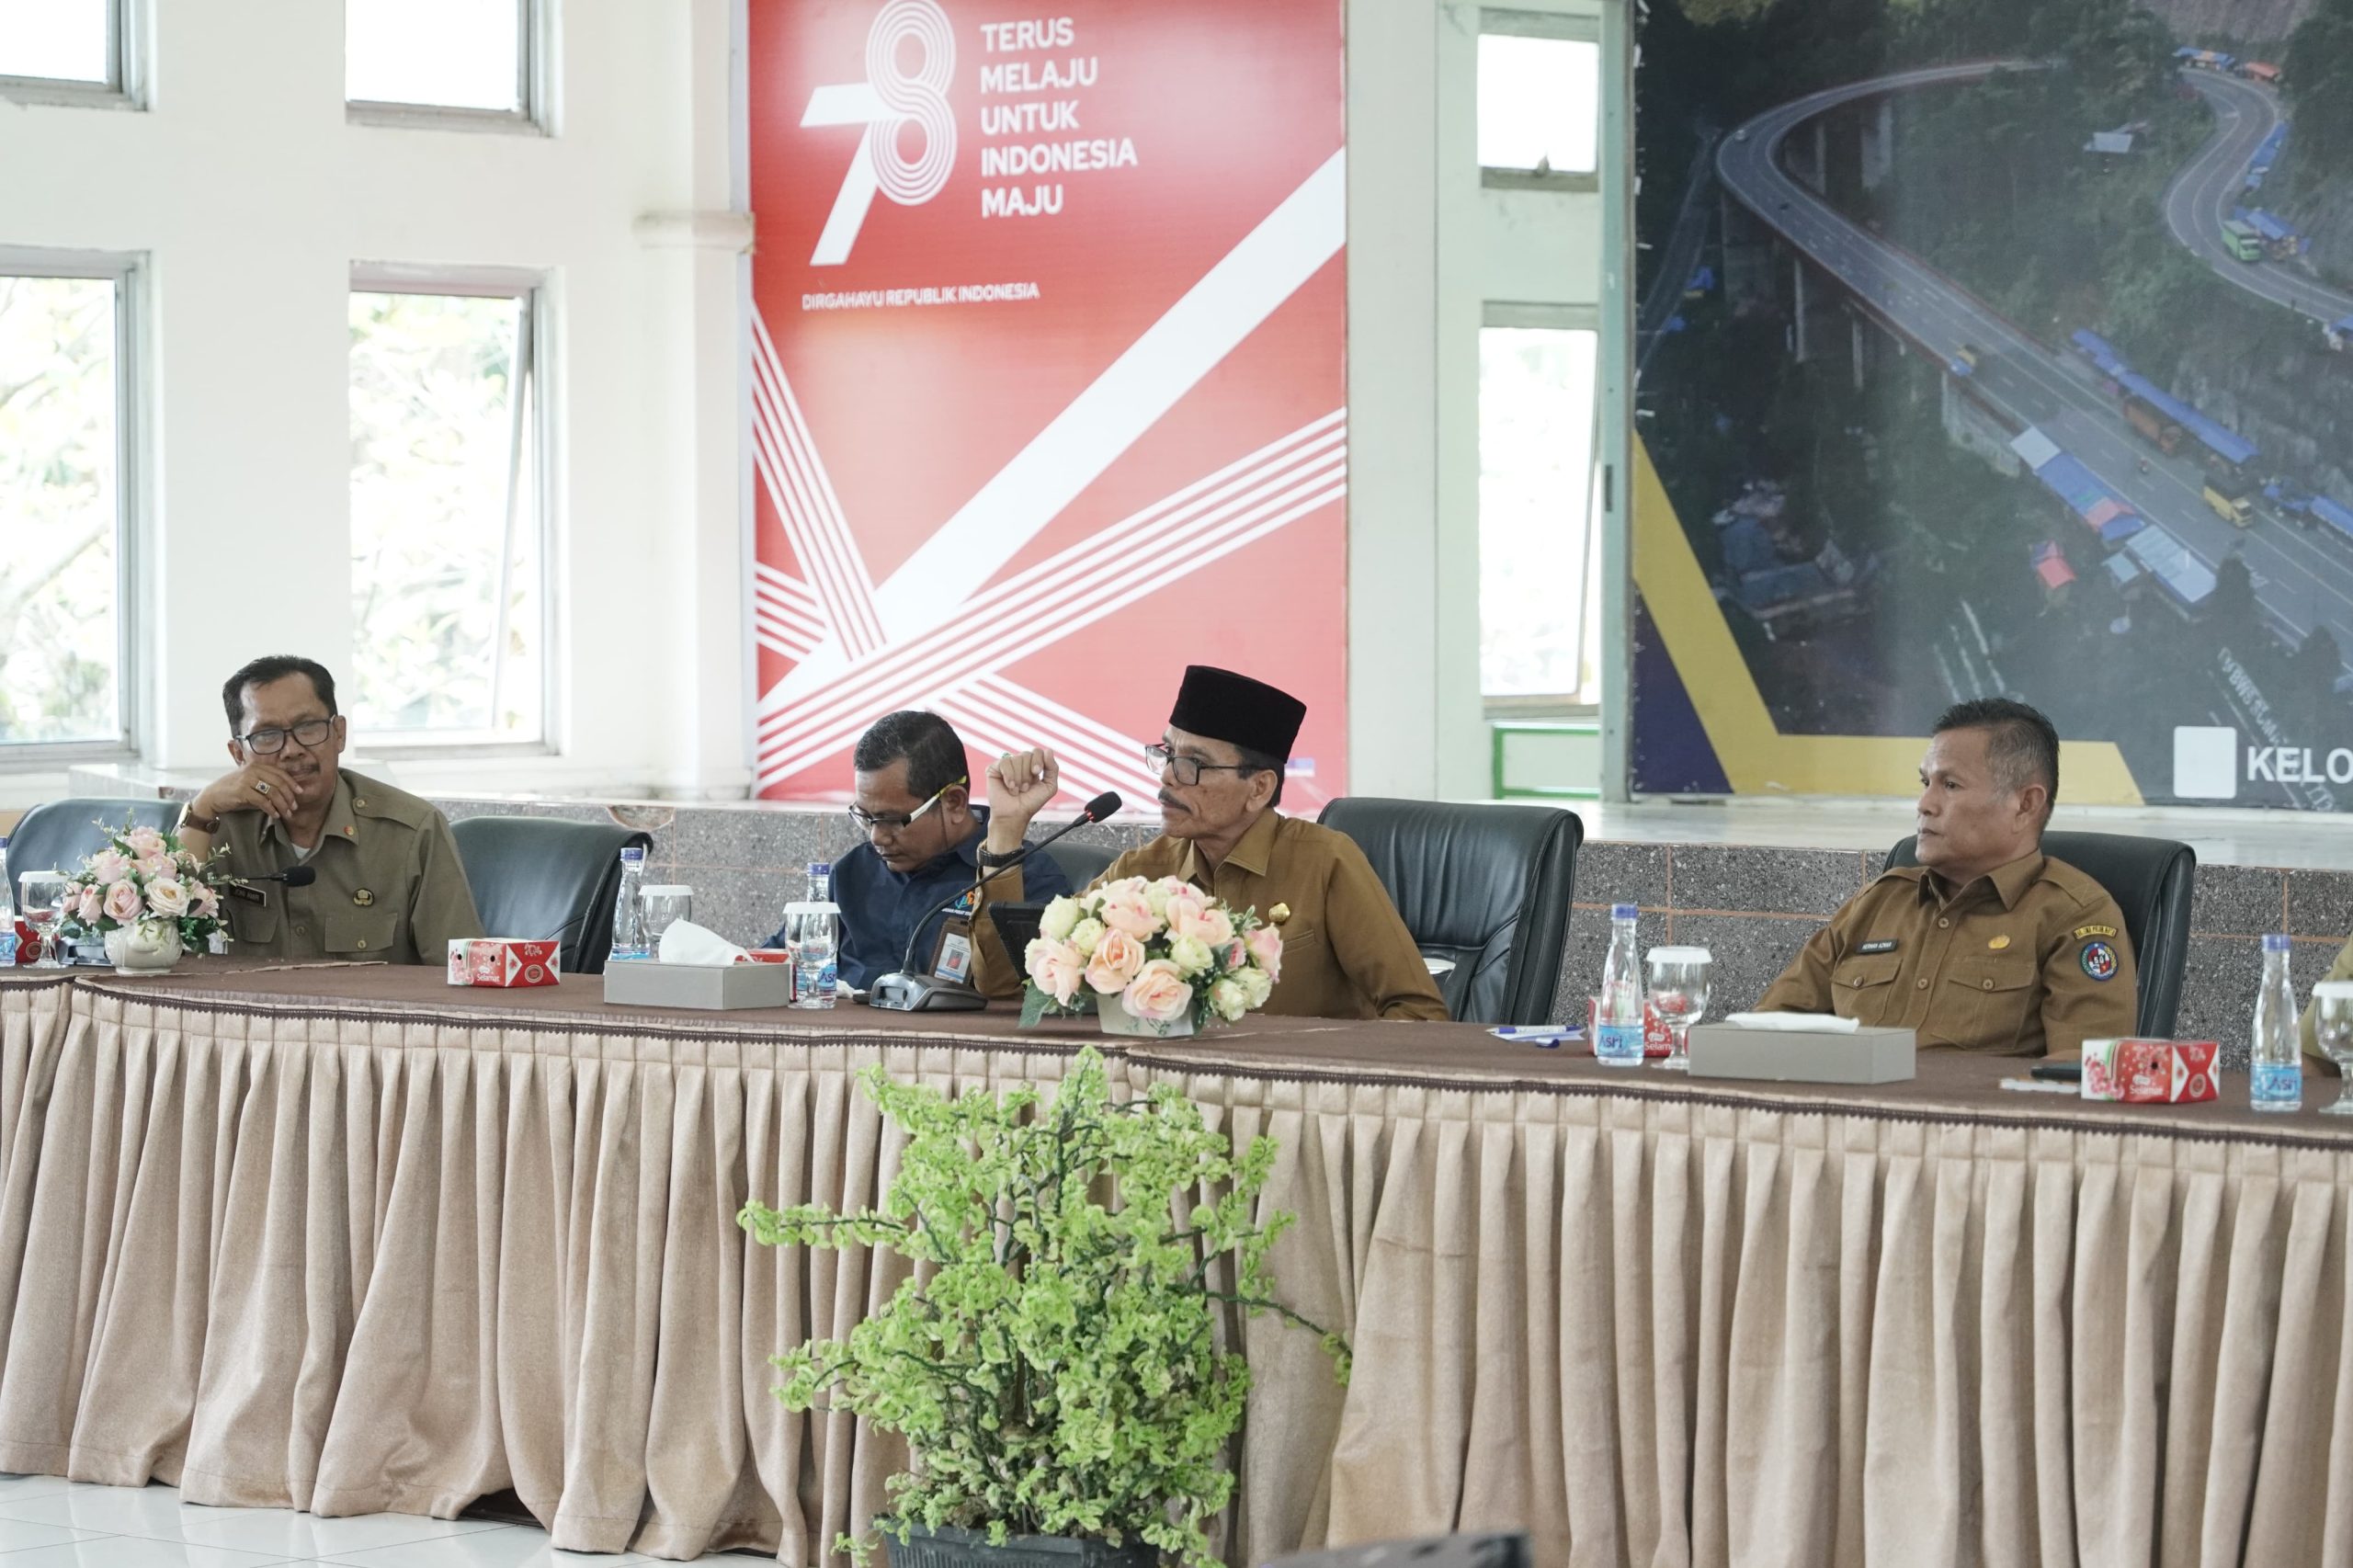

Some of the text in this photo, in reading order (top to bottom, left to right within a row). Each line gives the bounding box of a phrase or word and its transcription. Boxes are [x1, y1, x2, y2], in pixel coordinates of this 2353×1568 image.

[980, 17, 1074, 52] TERUS
[980, 57, 1098, 94] MELAJU
[800, 0, 957, 266] 78
[981, 100, 1079, 135] UNTUK
[981, 138, 1138, 176] INDONESIA
[982, 184, 1063, 219] MAJU
[801, 282, 1040, 311] DIRGAHAYU REPUBLIK INDONESIA
[2247, 746, 2353, 784] KELO
